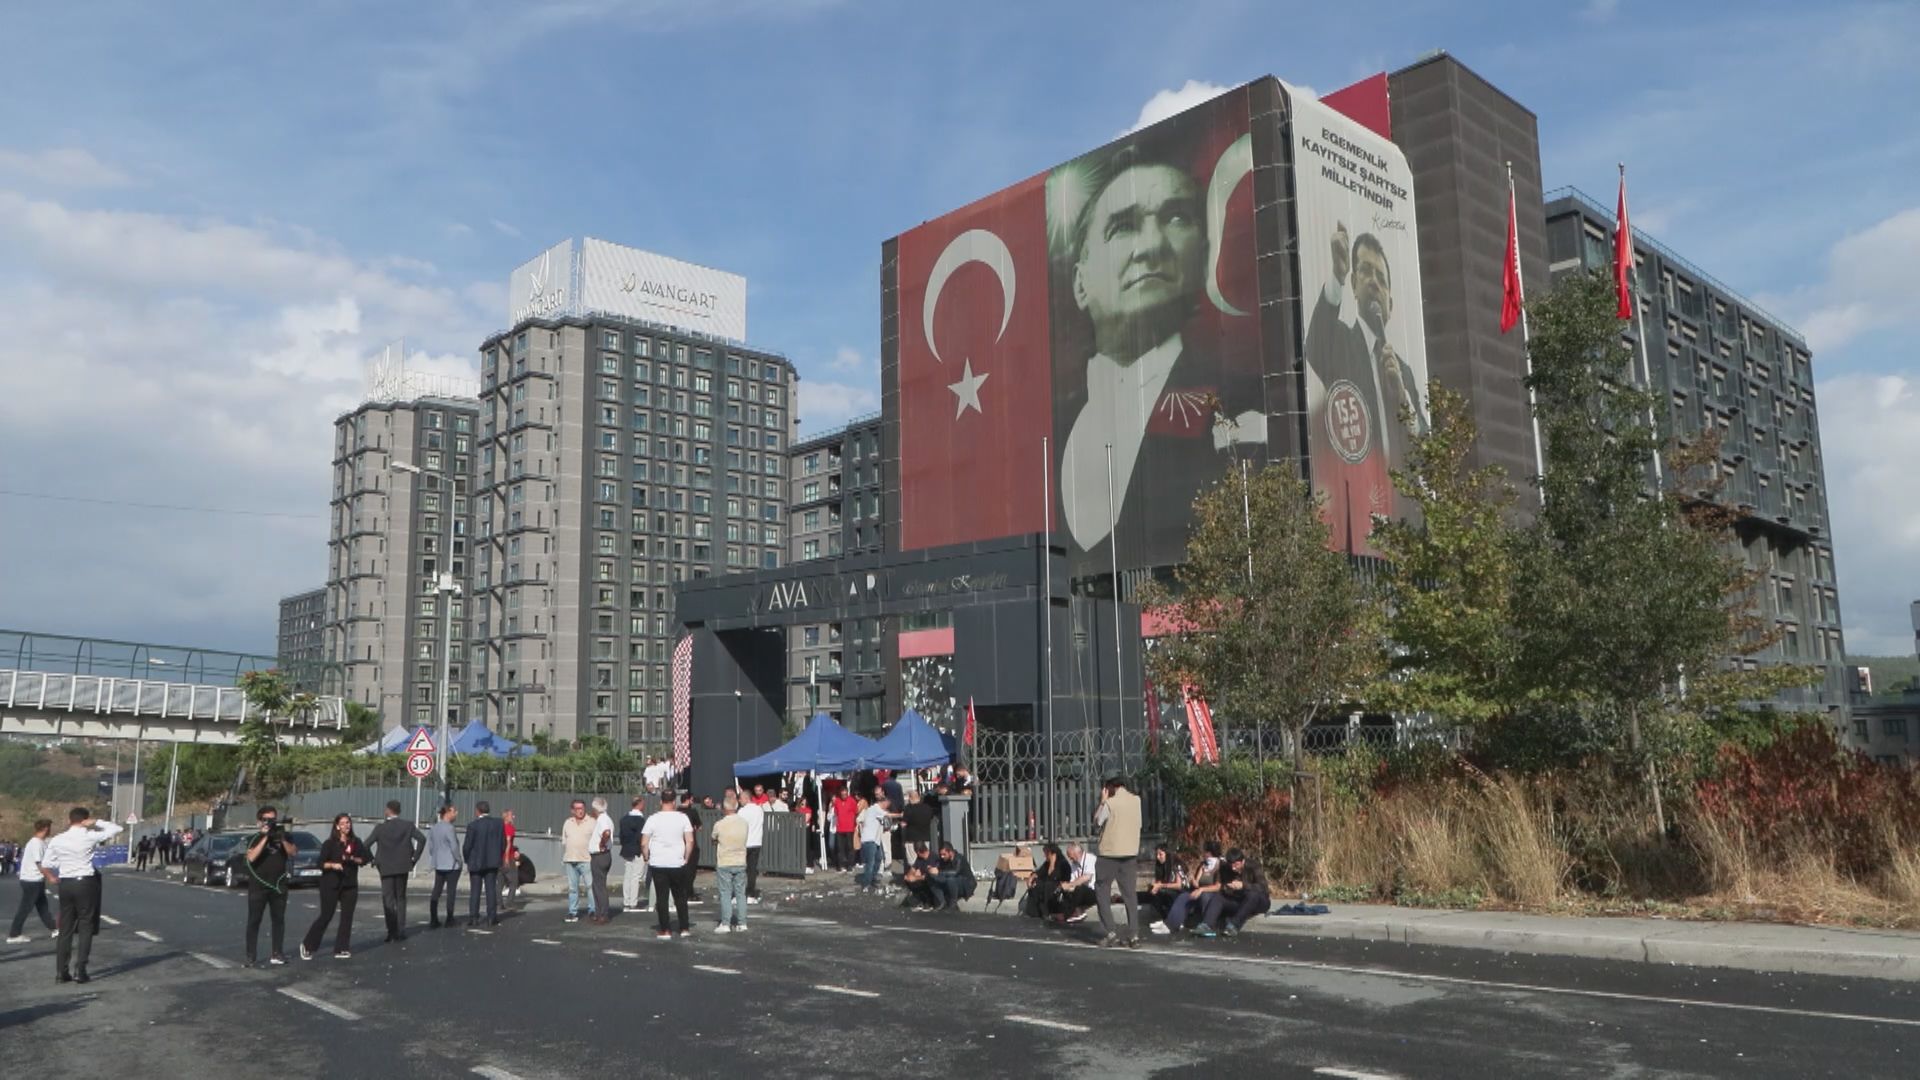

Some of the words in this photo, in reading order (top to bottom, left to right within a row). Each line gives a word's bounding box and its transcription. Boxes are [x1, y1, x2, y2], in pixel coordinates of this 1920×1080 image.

[1302, 135, 1357, 174] KAYITSIZ
[1359, 166, 1407, 201] ŞARTSIZ
[1321, 127, 1388, 173] EGEMENLİK
[1321, 165, 1393, 211] MİLLETİNDİR
[640, 280, 717, 310] AVANGART
[413, 759, 428, 770] 30
